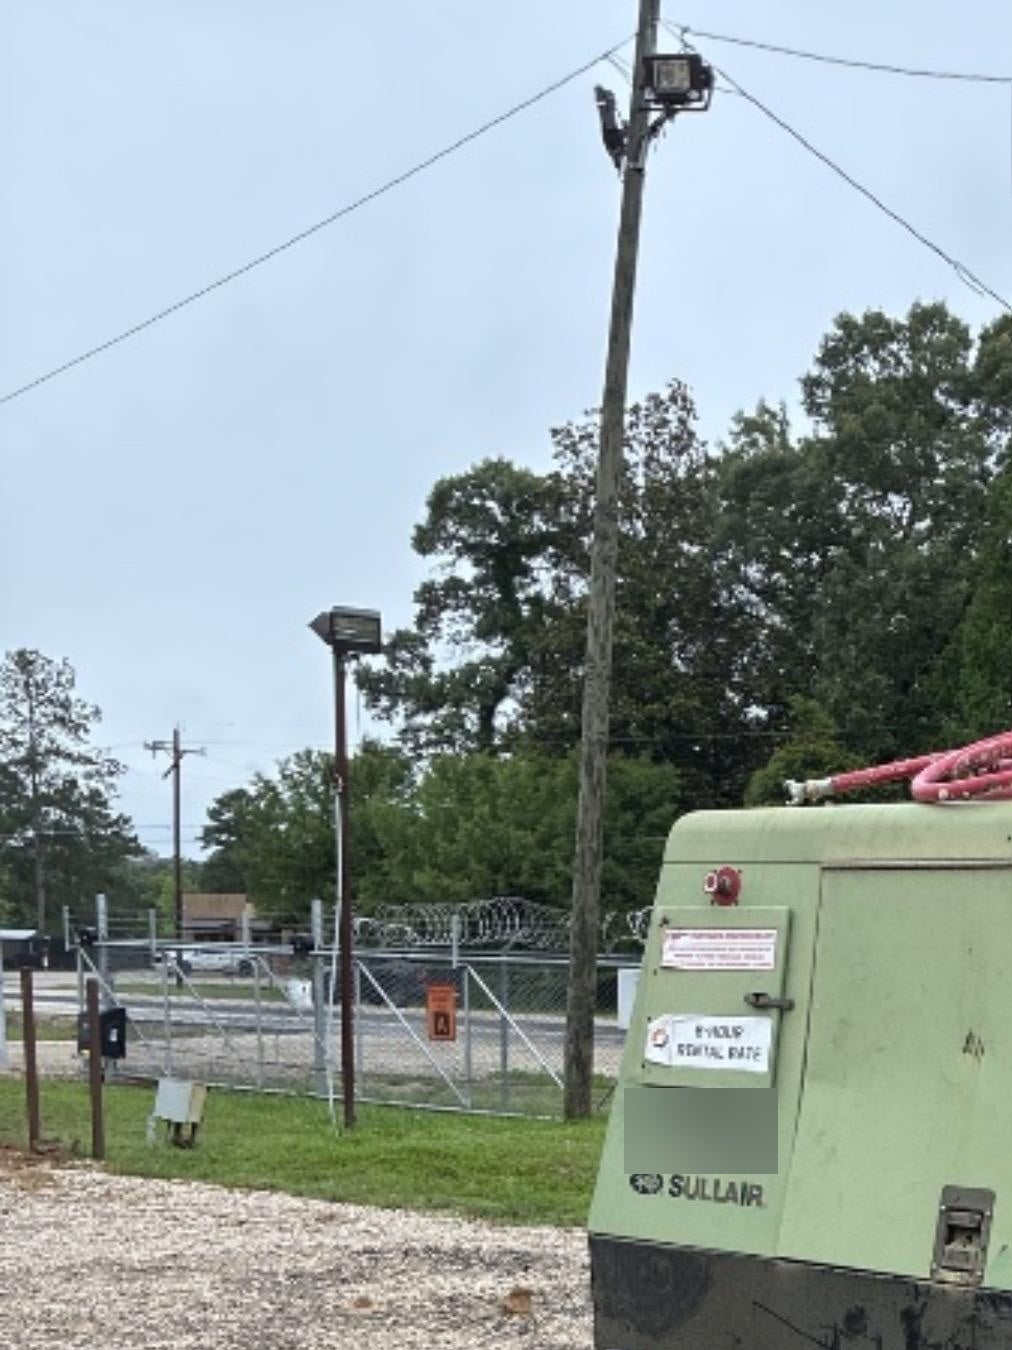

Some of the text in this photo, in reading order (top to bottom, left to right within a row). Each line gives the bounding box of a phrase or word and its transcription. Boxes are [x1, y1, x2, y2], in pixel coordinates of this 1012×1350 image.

[677, 1043, 763, 1063] RENTAL RATE
[667, 1173, 765, 1208] SULLAIR
